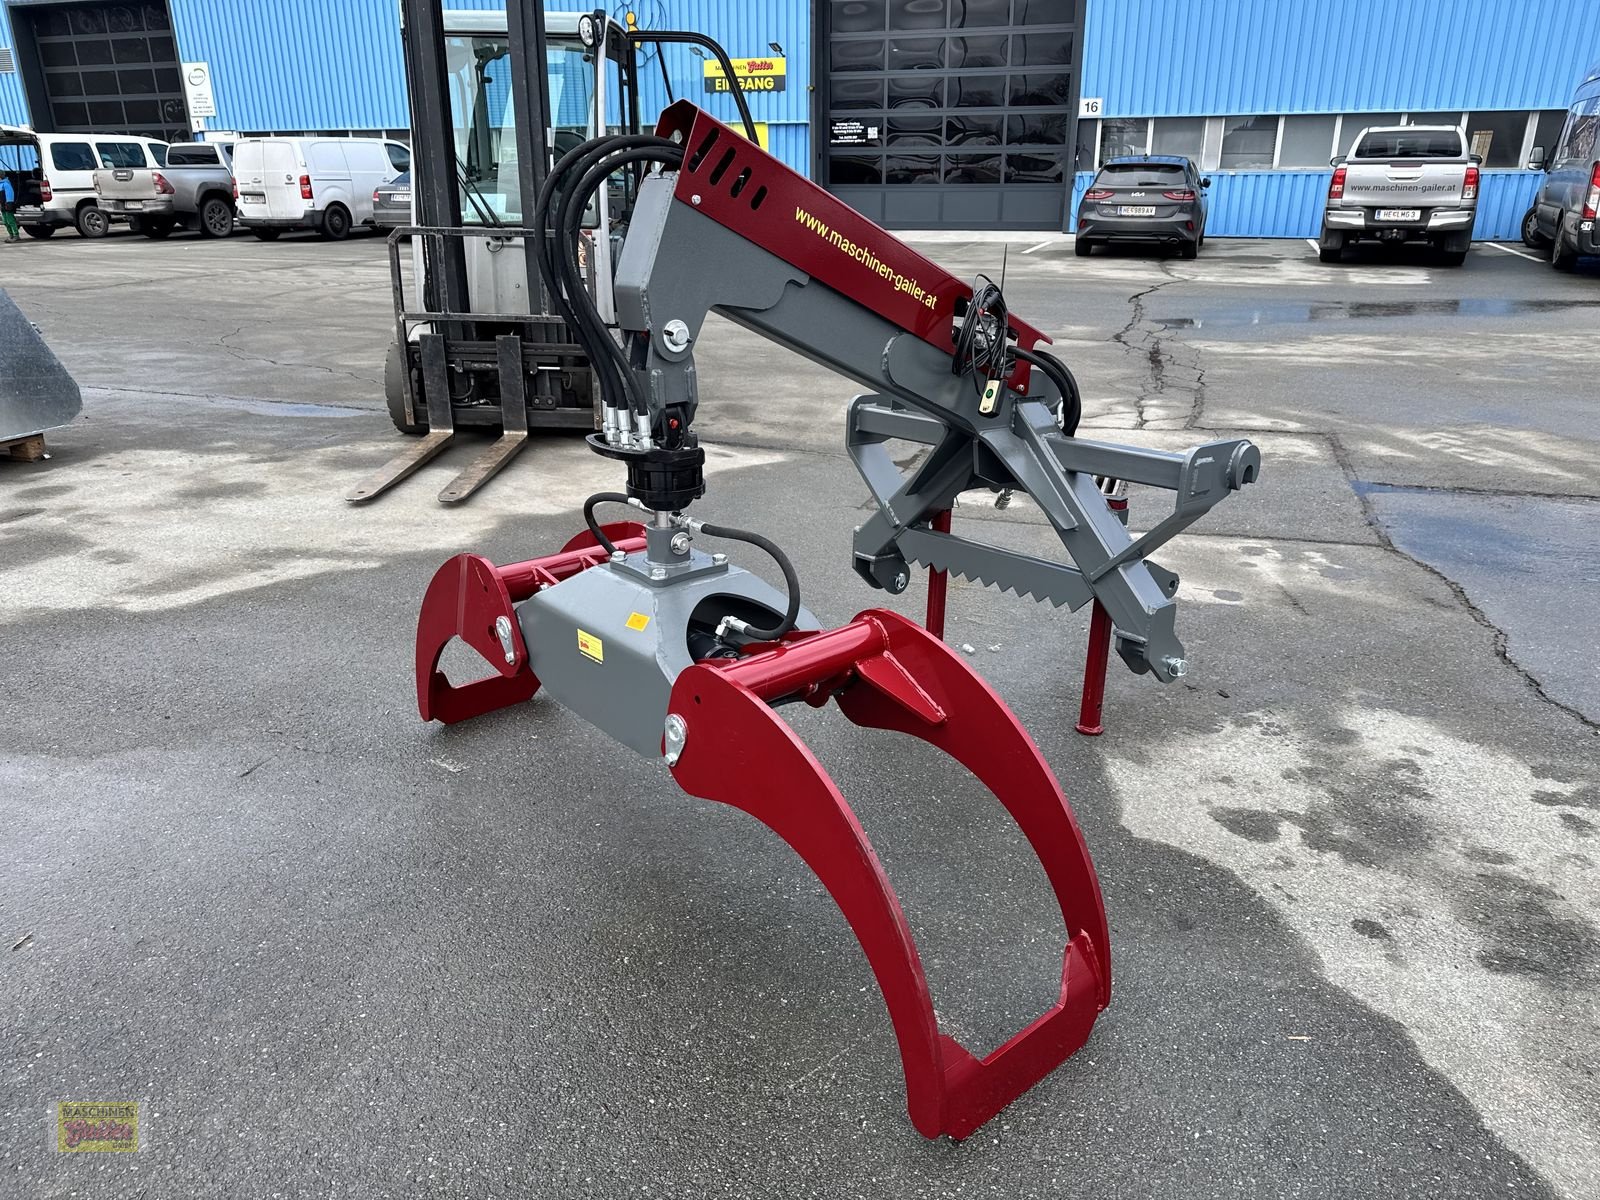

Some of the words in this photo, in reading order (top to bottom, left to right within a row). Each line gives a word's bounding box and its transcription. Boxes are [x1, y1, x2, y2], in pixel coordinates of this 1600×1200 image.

[1085, 101, 1098, 112] 16
[196, 120, 200, 128] 1
[1351, 184, 1456, 193] www.maschinen-gailer.at
[795, 206, 938, 310] www.maschinen-gailer.at
